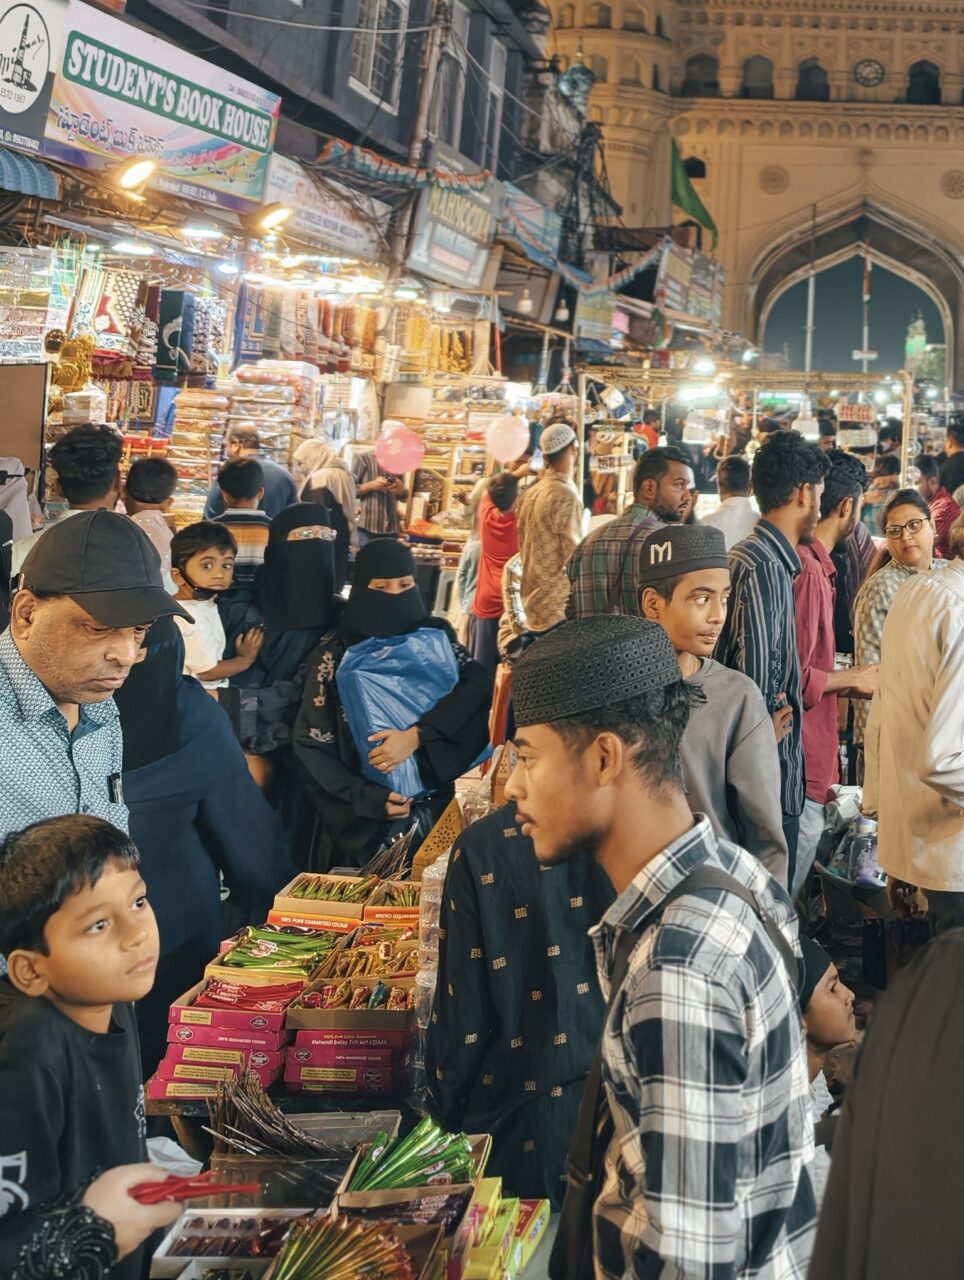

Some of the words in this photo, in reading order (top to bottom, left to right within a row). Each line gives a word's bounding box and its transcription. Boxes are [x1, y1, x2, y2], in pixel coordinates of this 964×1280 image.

[68, 38, 177, 113] STUDENT'S
[176, 84, 223, 133] BOOK
[223, 103, 270, 148] HOUSE
